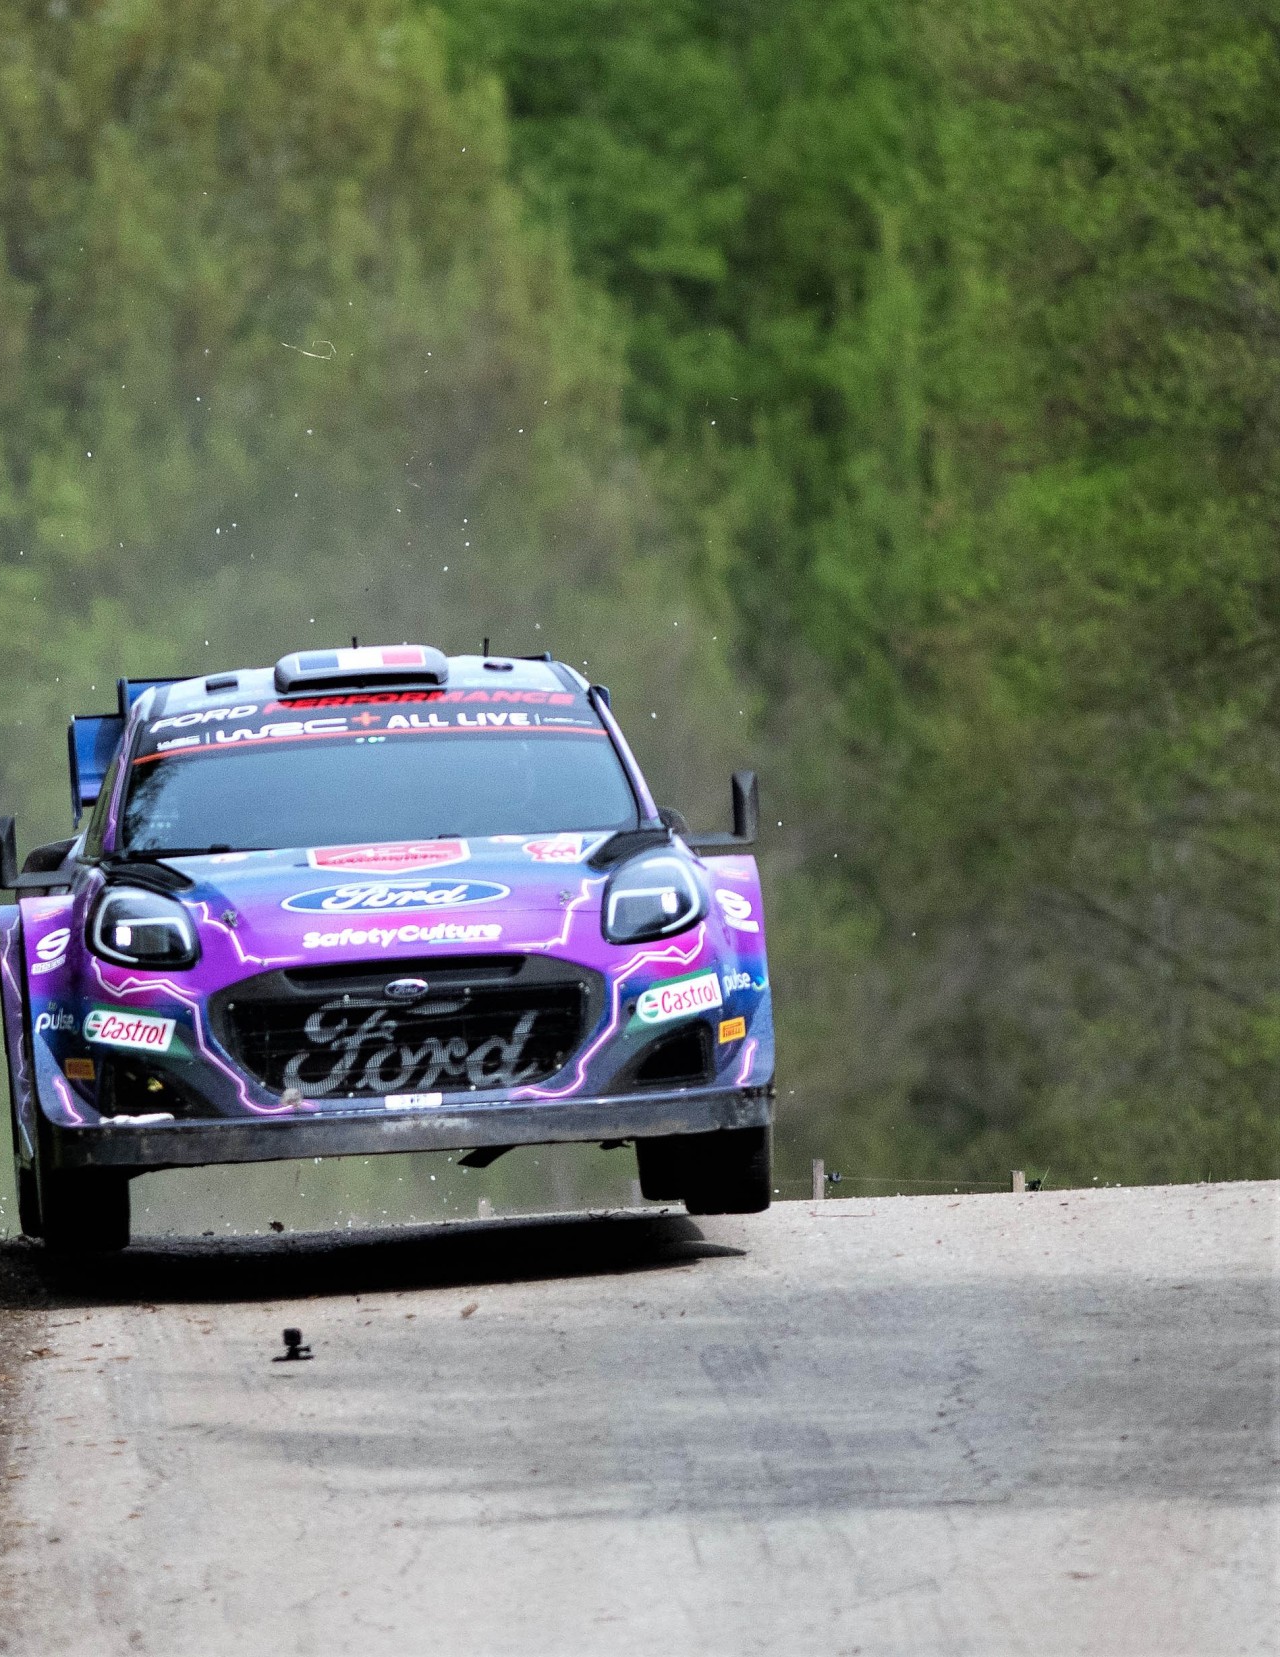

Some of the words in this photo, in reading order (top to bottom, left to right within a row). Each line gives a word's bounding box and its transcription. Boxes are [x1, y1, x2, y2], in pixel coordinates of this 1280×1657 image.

[149, 704, 258, 734] FORD
[387, 713, 450, 729] ALL
[456, 712, 531, 727] LIVE
[320, 881, 470, 910] Ford
[302, 922, 503, 949] SafetyCulture
[661, 980, 719, 1014] Castrol
[722, 967, 752, 997] pulse
[100, 1016, 168, 1046] Castrol
[282, 997, 540, 1097] Ford
